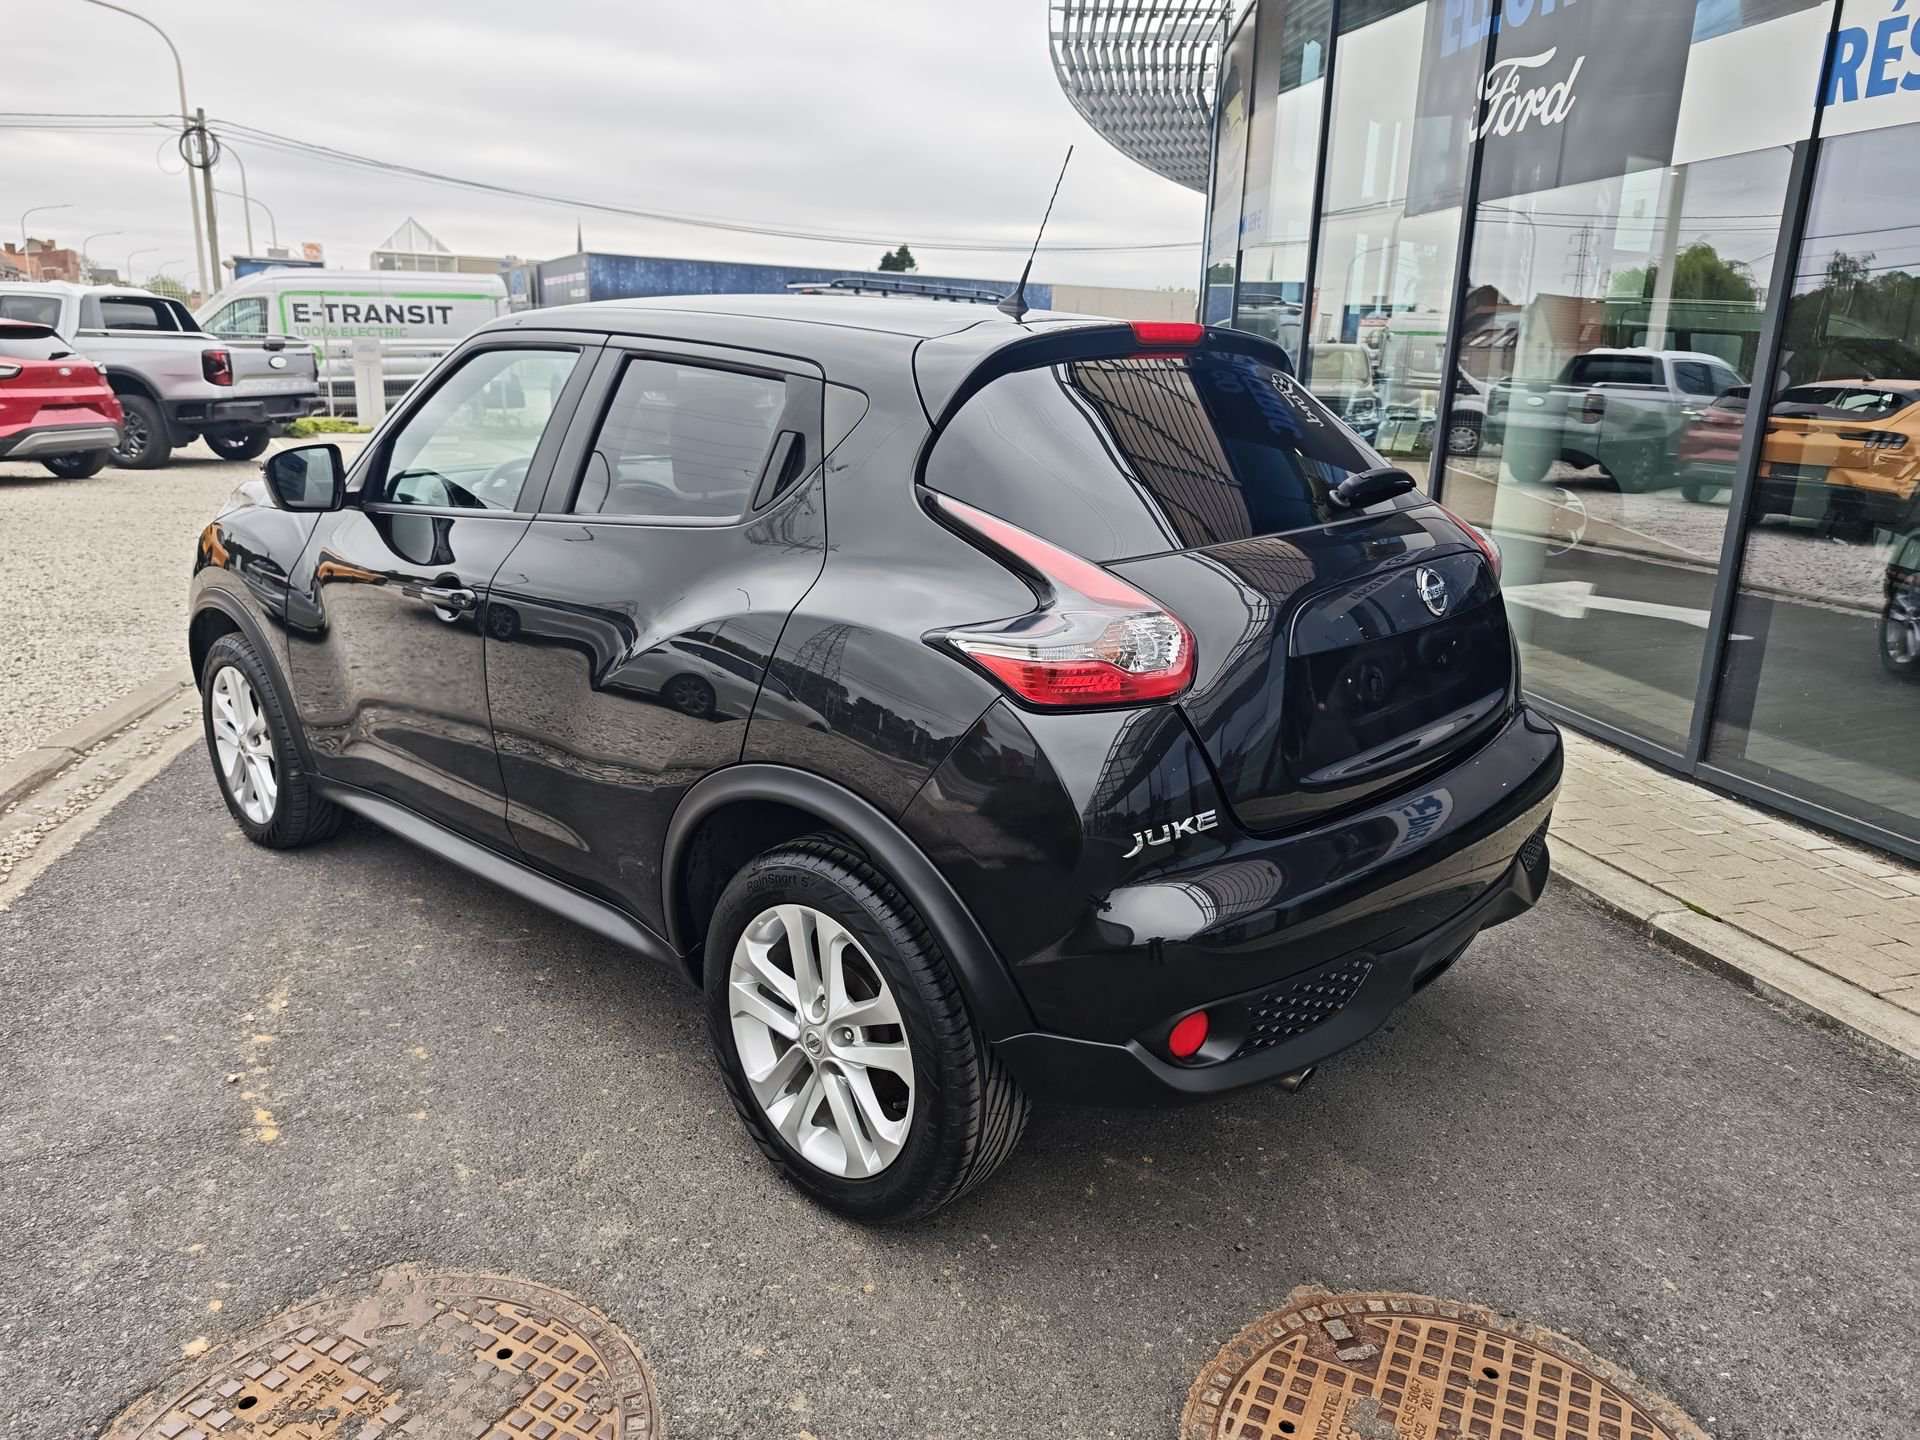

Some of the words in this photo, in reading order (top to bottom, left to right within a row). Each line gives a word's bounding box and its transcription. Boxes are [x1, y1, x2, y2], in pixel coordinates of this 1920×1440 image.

[1468, 46, 1586, 144] Ford
[292, 302, 453, 324] E-TRANSIT
[341, 327, 409, 338] ELECTRIC
[1121, 808, 1219, 859] JUKE
